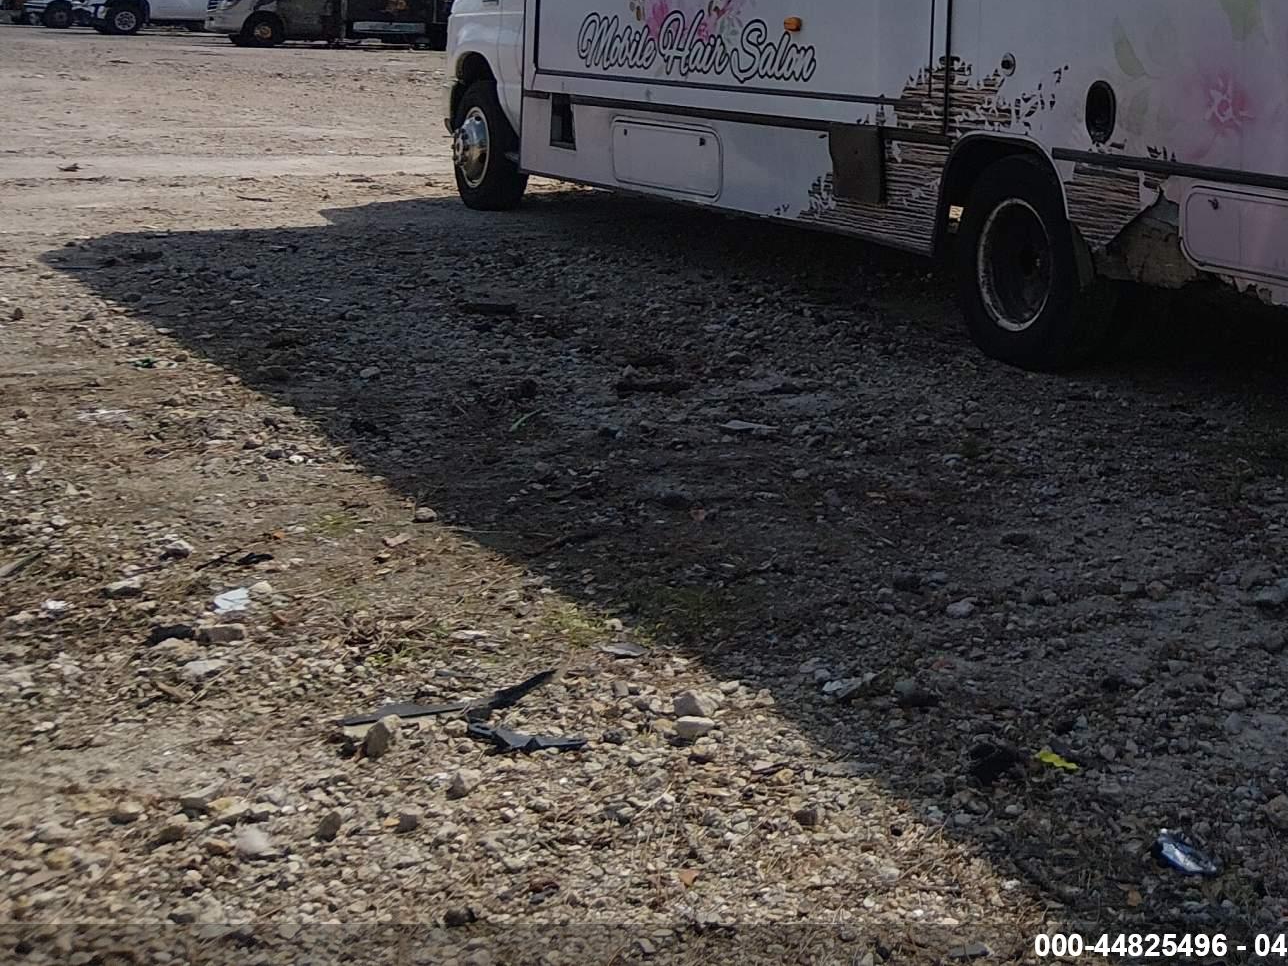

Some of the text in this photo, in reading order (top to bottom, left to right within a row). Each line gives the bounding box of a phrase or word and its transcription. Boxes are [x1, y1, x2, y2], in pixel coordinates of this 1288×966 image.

[577, 9, 817, 84] Mobile Hair Salon
